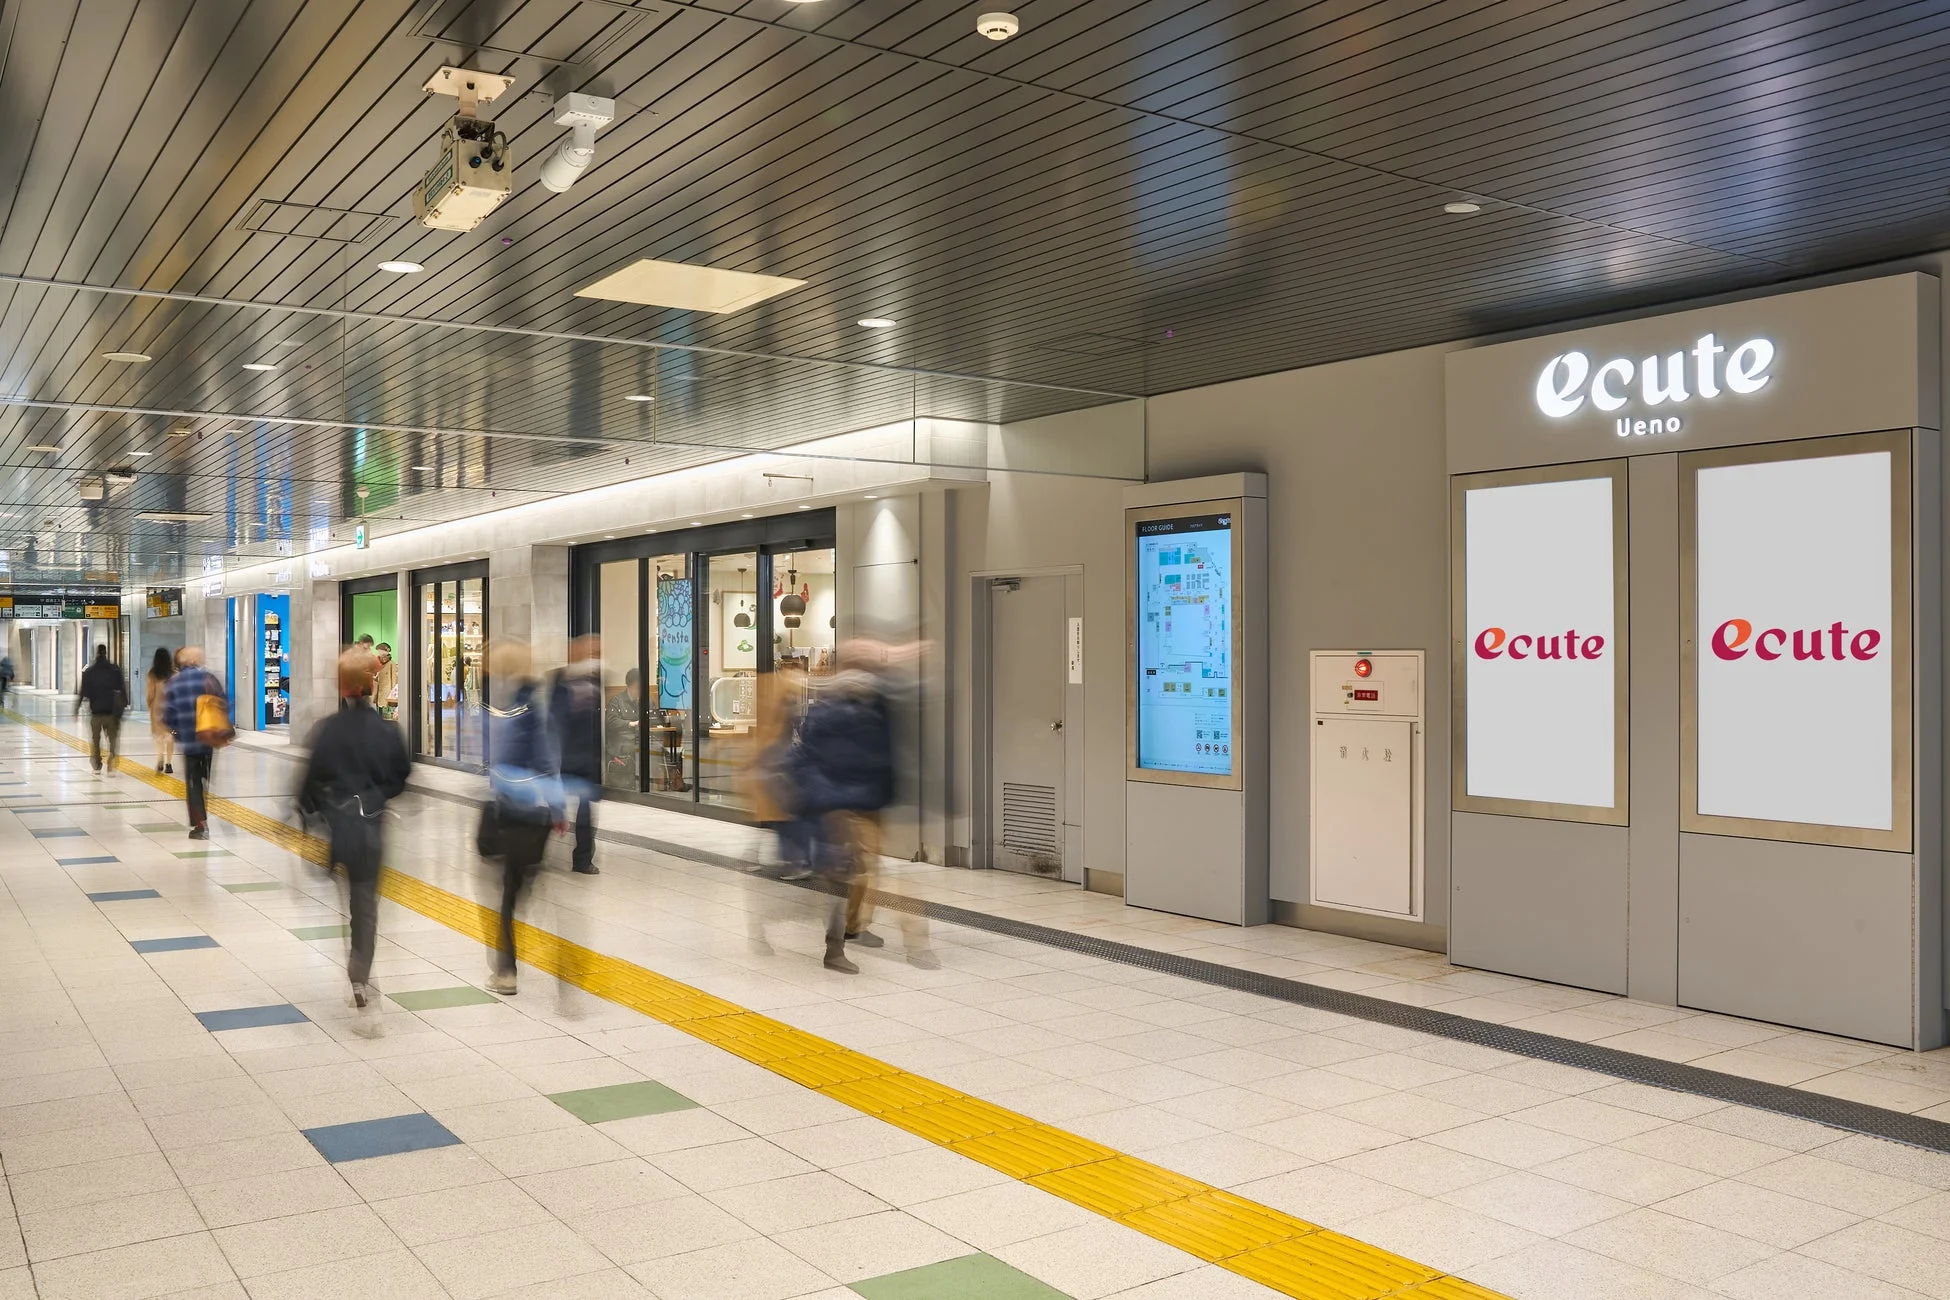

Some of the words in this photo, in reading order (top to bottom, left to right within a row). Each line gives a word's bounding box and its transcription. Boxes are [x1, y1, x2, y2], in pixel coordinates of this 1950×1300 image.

[1536, 333, 1775, 417] ecute
[1616, 415, 1681, 437] Ueno
[1158, 523, 1174, 531] GUIDE
[661, 629, 689, 643] Pensta
[1474, 627, 1605, 660] ecute
[1712, 618, 1881, 661] ecute
